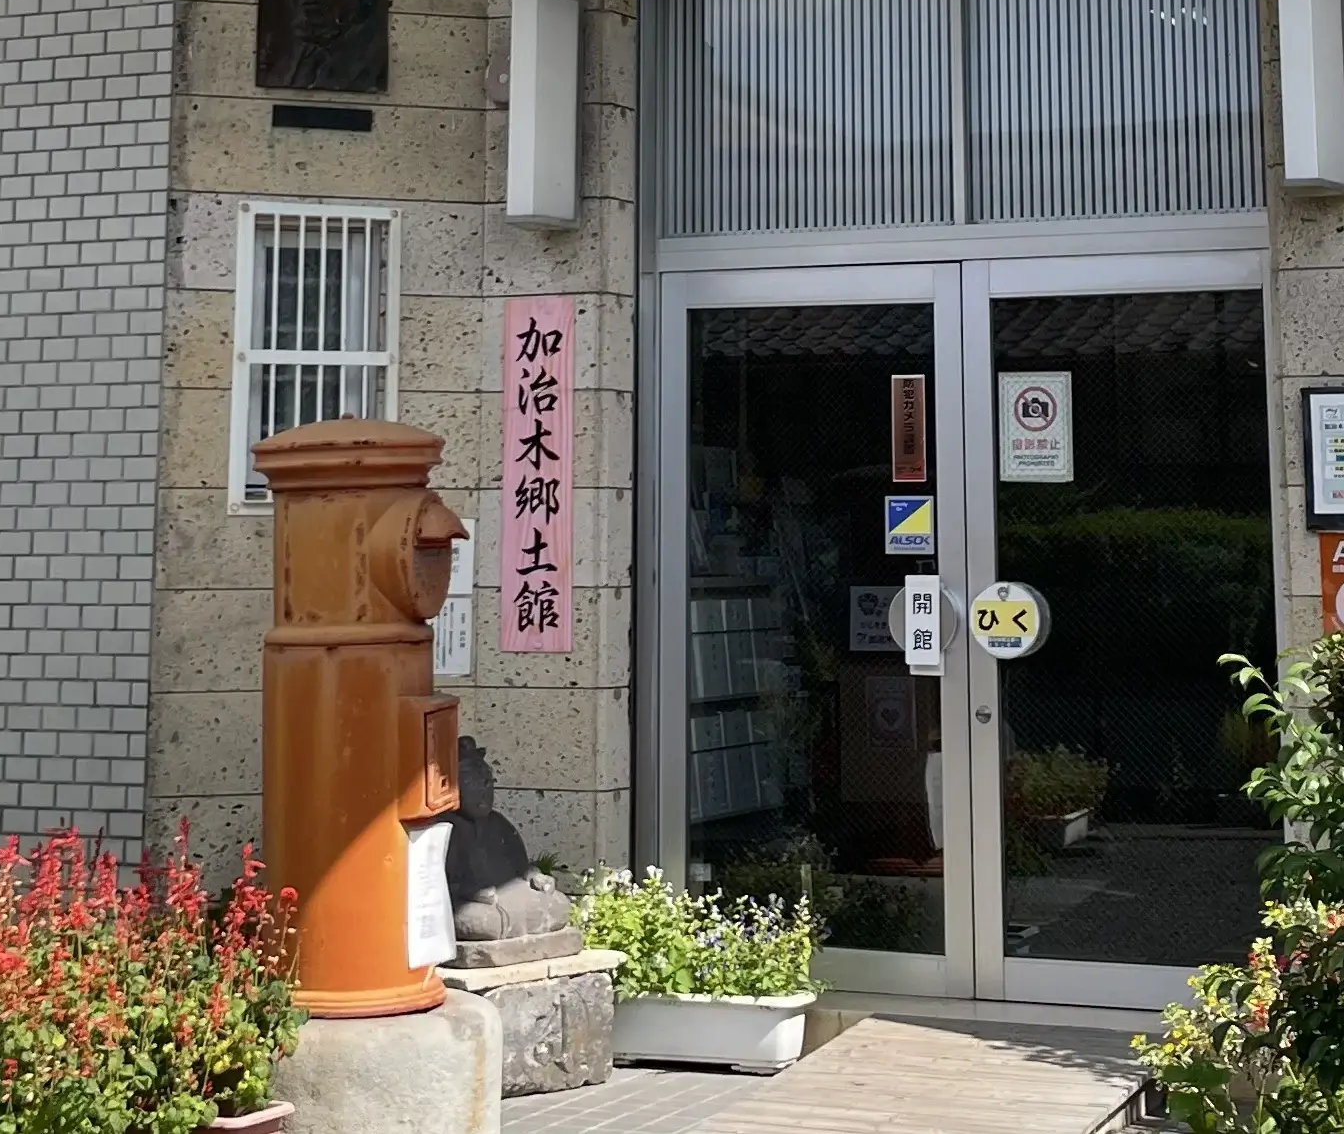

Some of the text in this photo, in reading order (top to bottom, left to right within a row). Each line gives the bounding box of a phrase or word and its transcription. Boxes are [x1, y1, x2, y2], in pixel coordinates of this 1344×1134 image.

[513, 316, 563, 634] 加治木郷土館
[889, 535, 931, 546] ALSOK
[912, 593, 933, 651] 開館
[977, 609, 1028, 633] ひく
